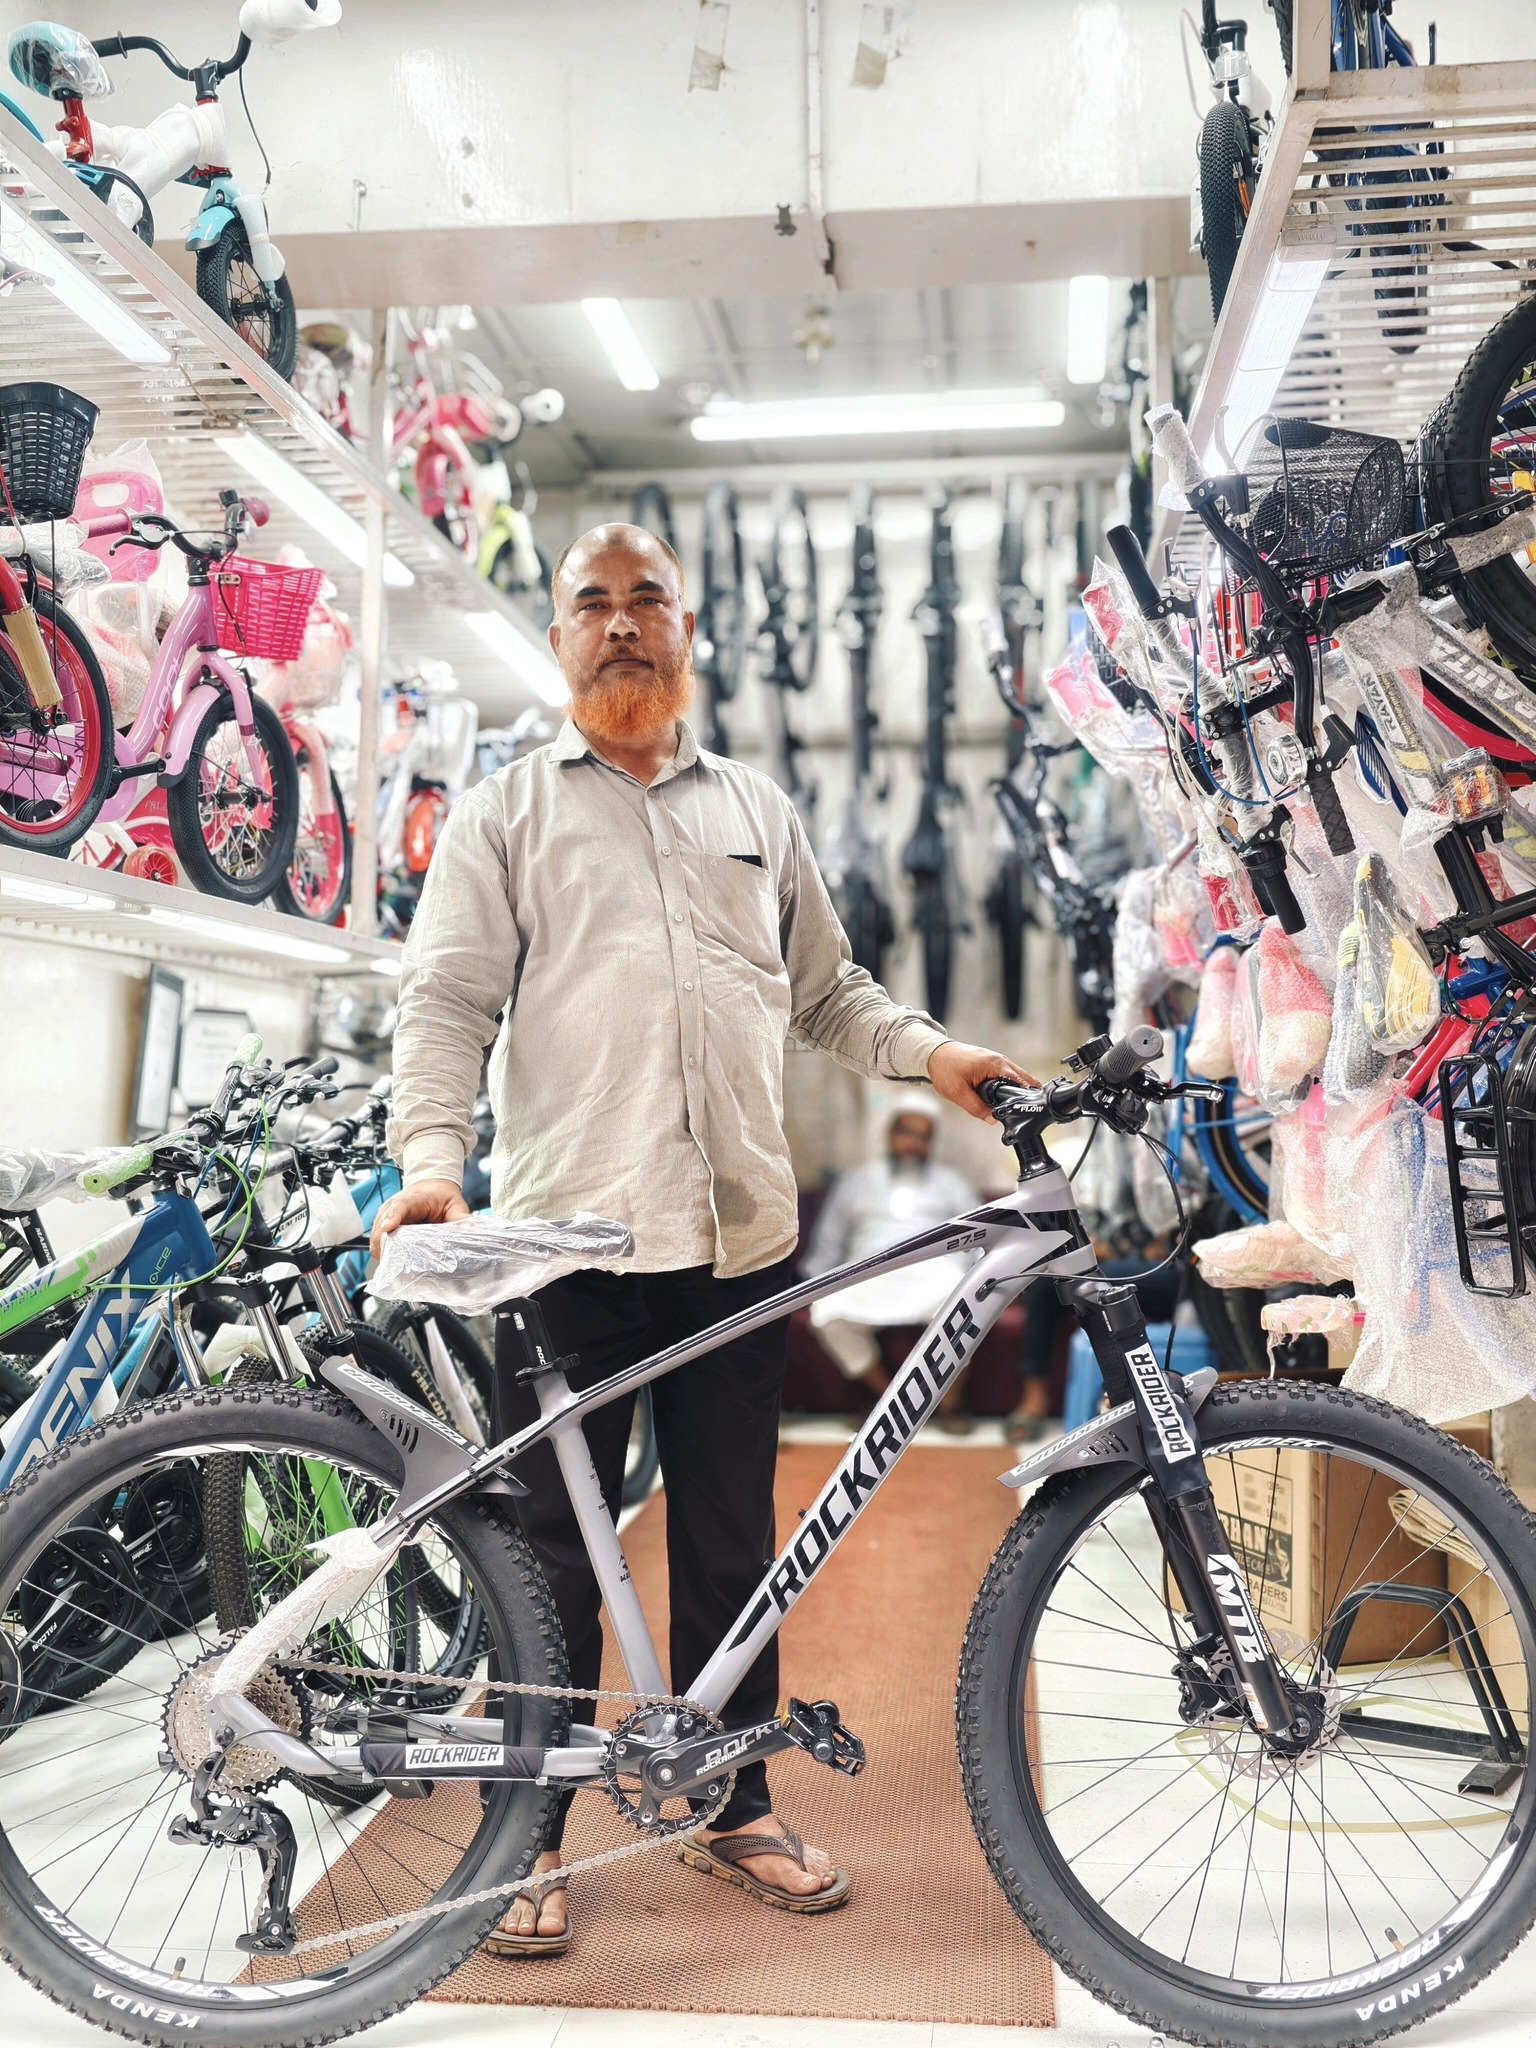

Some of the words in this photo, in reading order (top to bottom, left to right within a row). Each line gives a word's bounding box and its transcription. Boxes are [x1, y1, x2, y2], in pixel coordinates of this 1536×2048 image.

[947, 1229, 987, 1250] 27.5
[344, 1366, 463, 1441] ROCKRIDER
[411, 1370, 447, 1421] FALCON
[1130, 1352, 1190, 1453] ROCKRIDER
[768, 1298, 981, 1615] ROCKRIDER
[32, 1622, 58, 1652] FALCON
[1210, 1573, 1265, 1662] MTB
[409, 1747, 500, 1764] ROCKRIDER
[696, 1745, 748, 1776] ROCKRIDER
[34, 1904, 217, 1997] ROCKRIDER
[1255, 1929, 1440, 1998] ROCKRIDER
[92, 1983, 200, 2029] KENDA
[1355, 1955, 1465, 2021] KENDA
